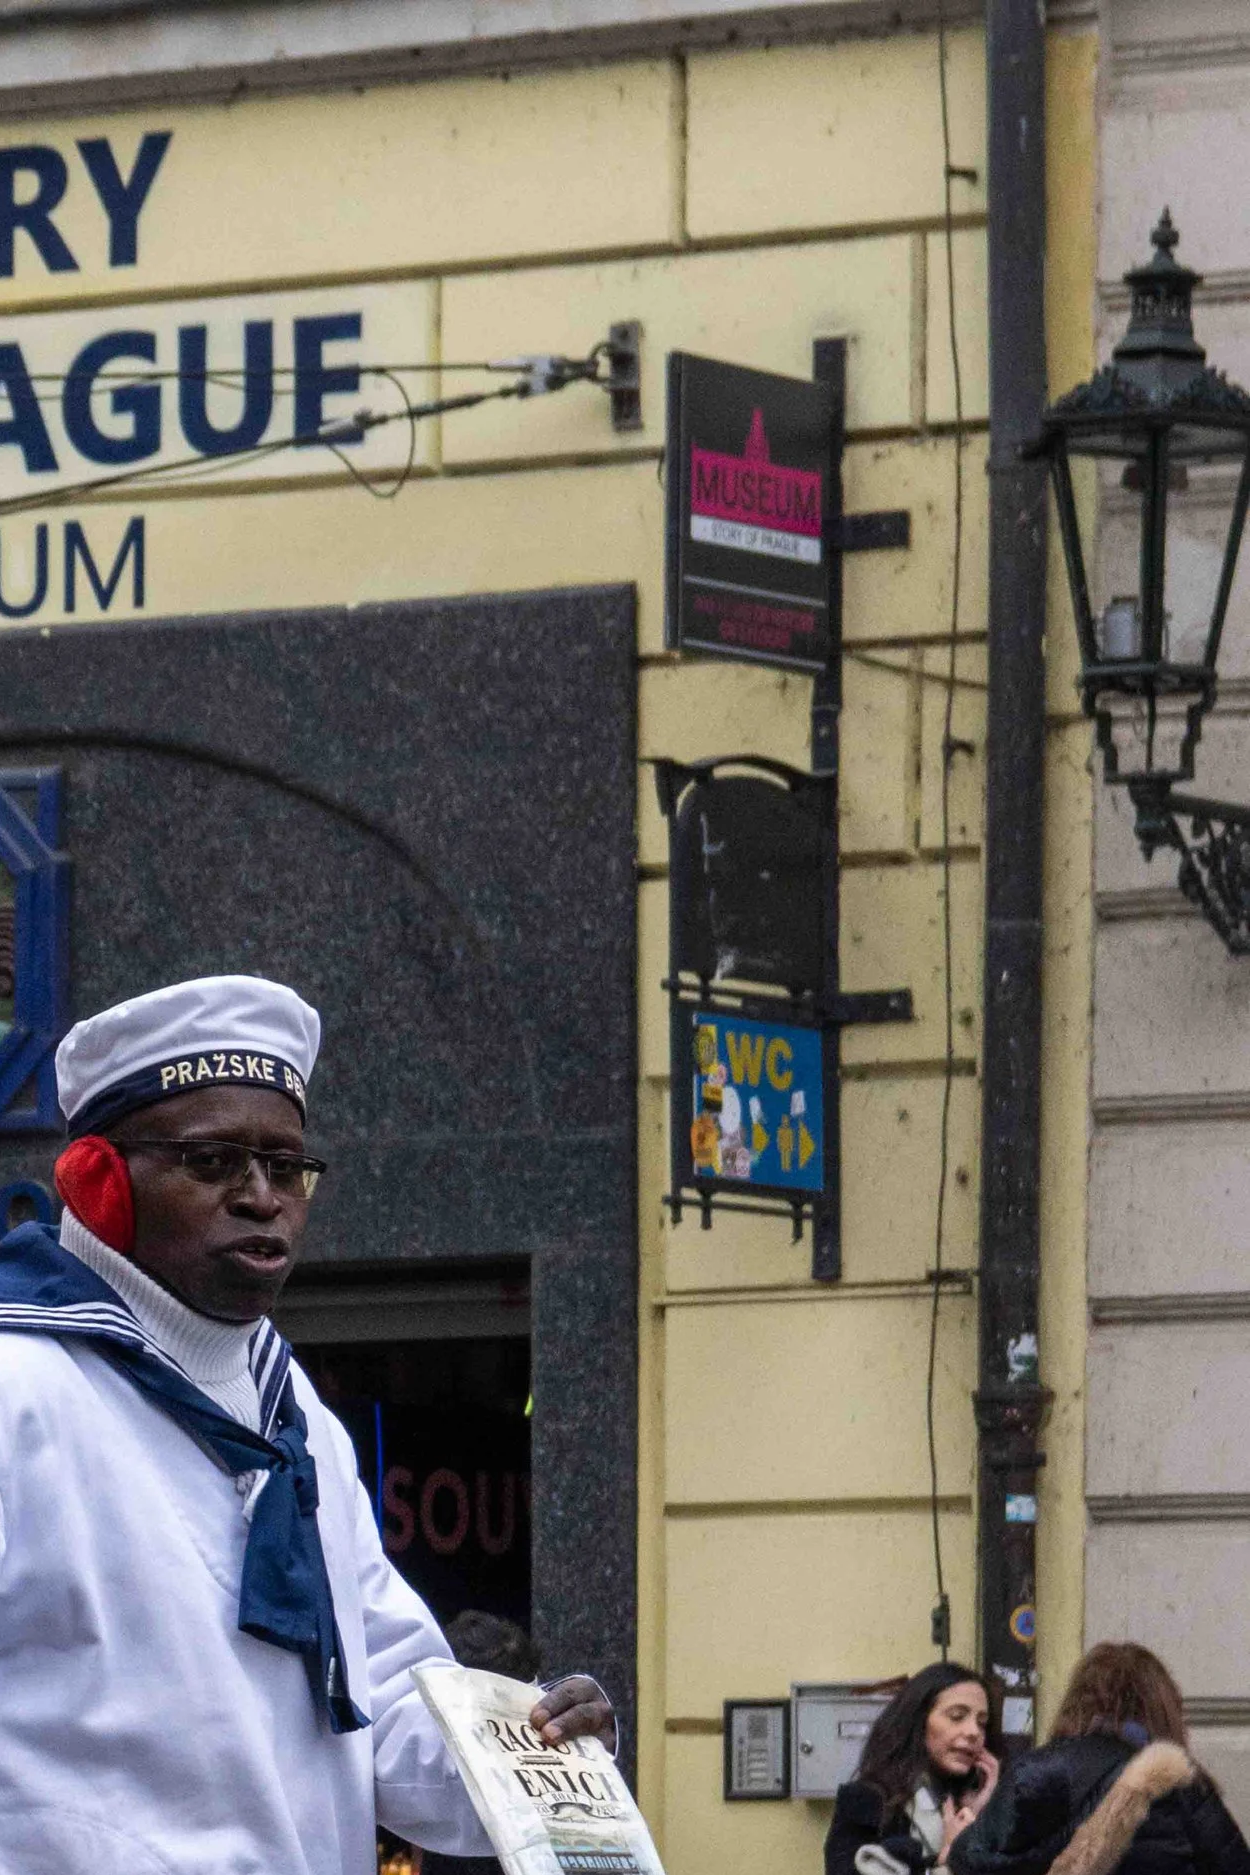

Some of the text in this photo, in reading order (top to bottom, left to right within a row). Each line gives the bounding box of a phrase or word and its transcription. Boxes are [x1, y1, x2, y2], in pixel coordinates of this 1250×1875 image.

[696, 461, 818, 523] MUSEUM
[283, 1065, 306, 1100] BE
[725, 1030, 793, 1091] WC
[383, 1465, 528, 1555] SOU
